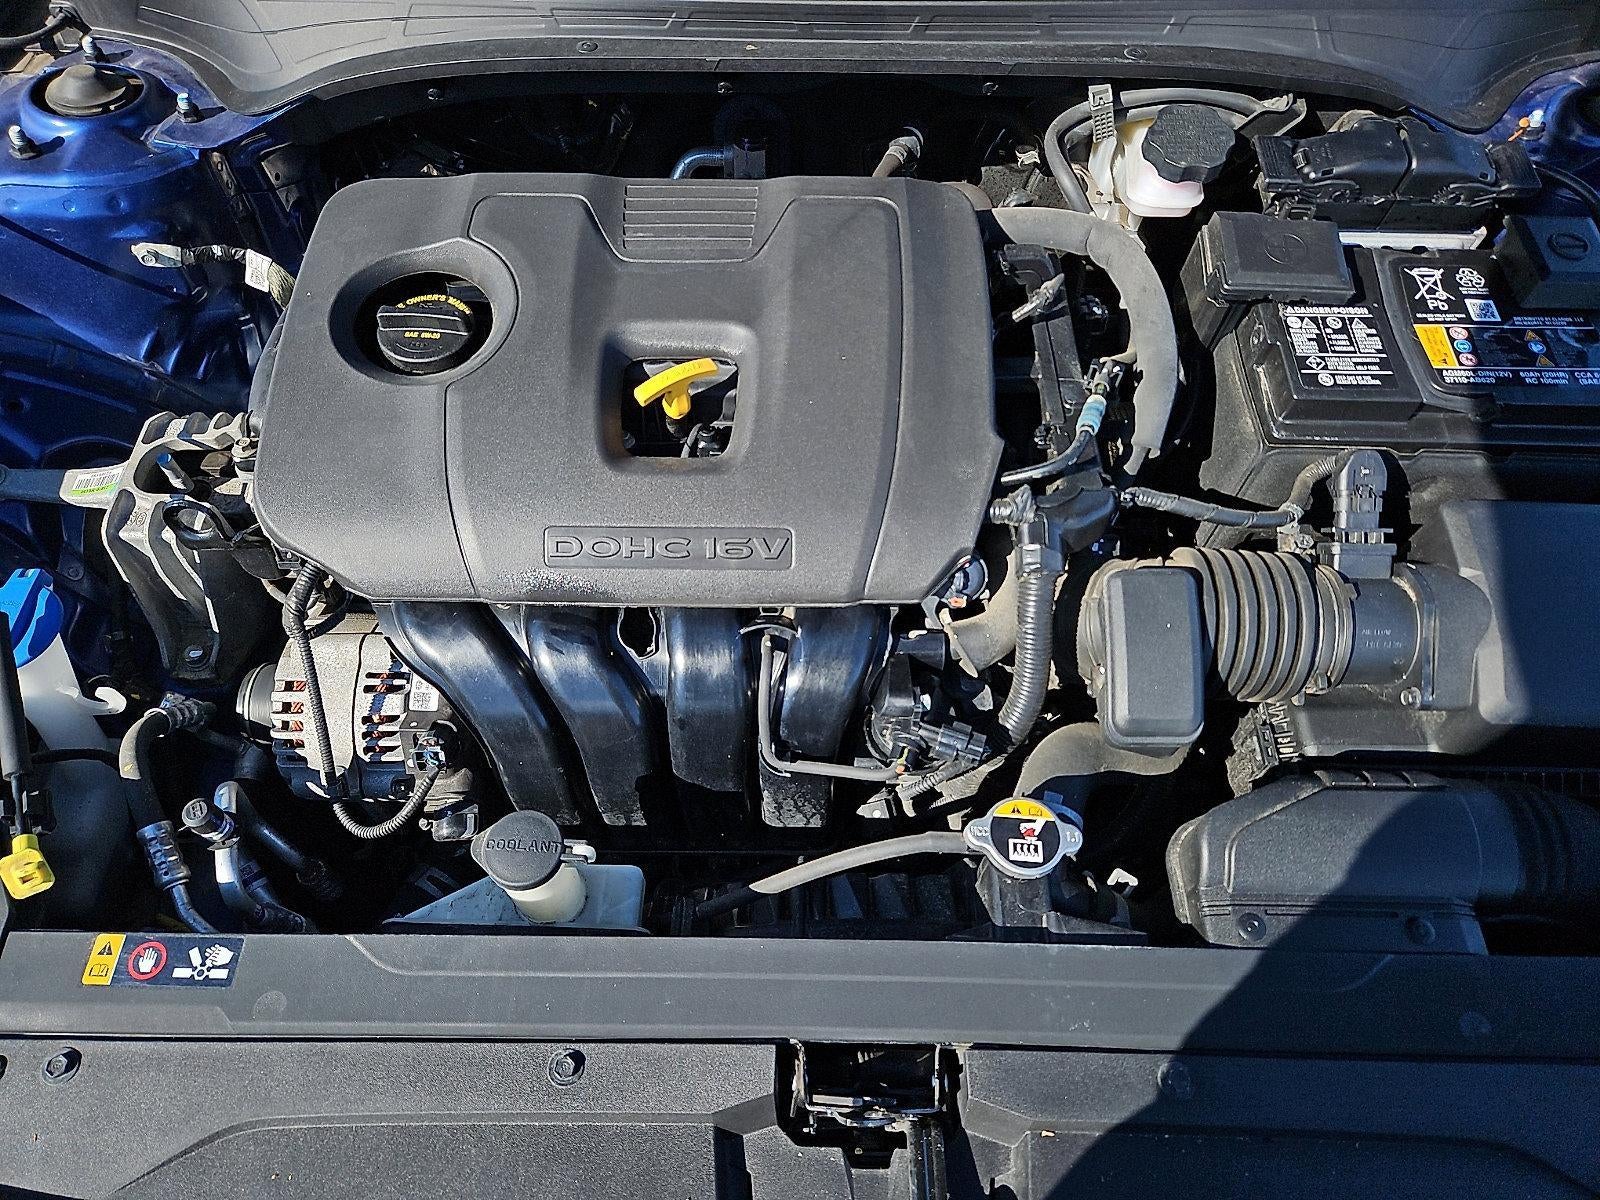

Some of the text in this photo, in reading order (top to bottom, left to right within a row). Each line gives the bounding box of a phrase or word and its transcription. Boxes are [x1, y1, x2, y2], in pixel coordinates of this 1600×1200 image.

[406, 294, 447, 305] OWNER'S
[1427, 300, 1449, 311] Pb
[1574, 371, 1593, 379] CCA
[548, 536, 790, 560] DOHC 16V
[1066, 831, 1080, 843] 1.1
[485, 839, 561, 854] COOLANT
